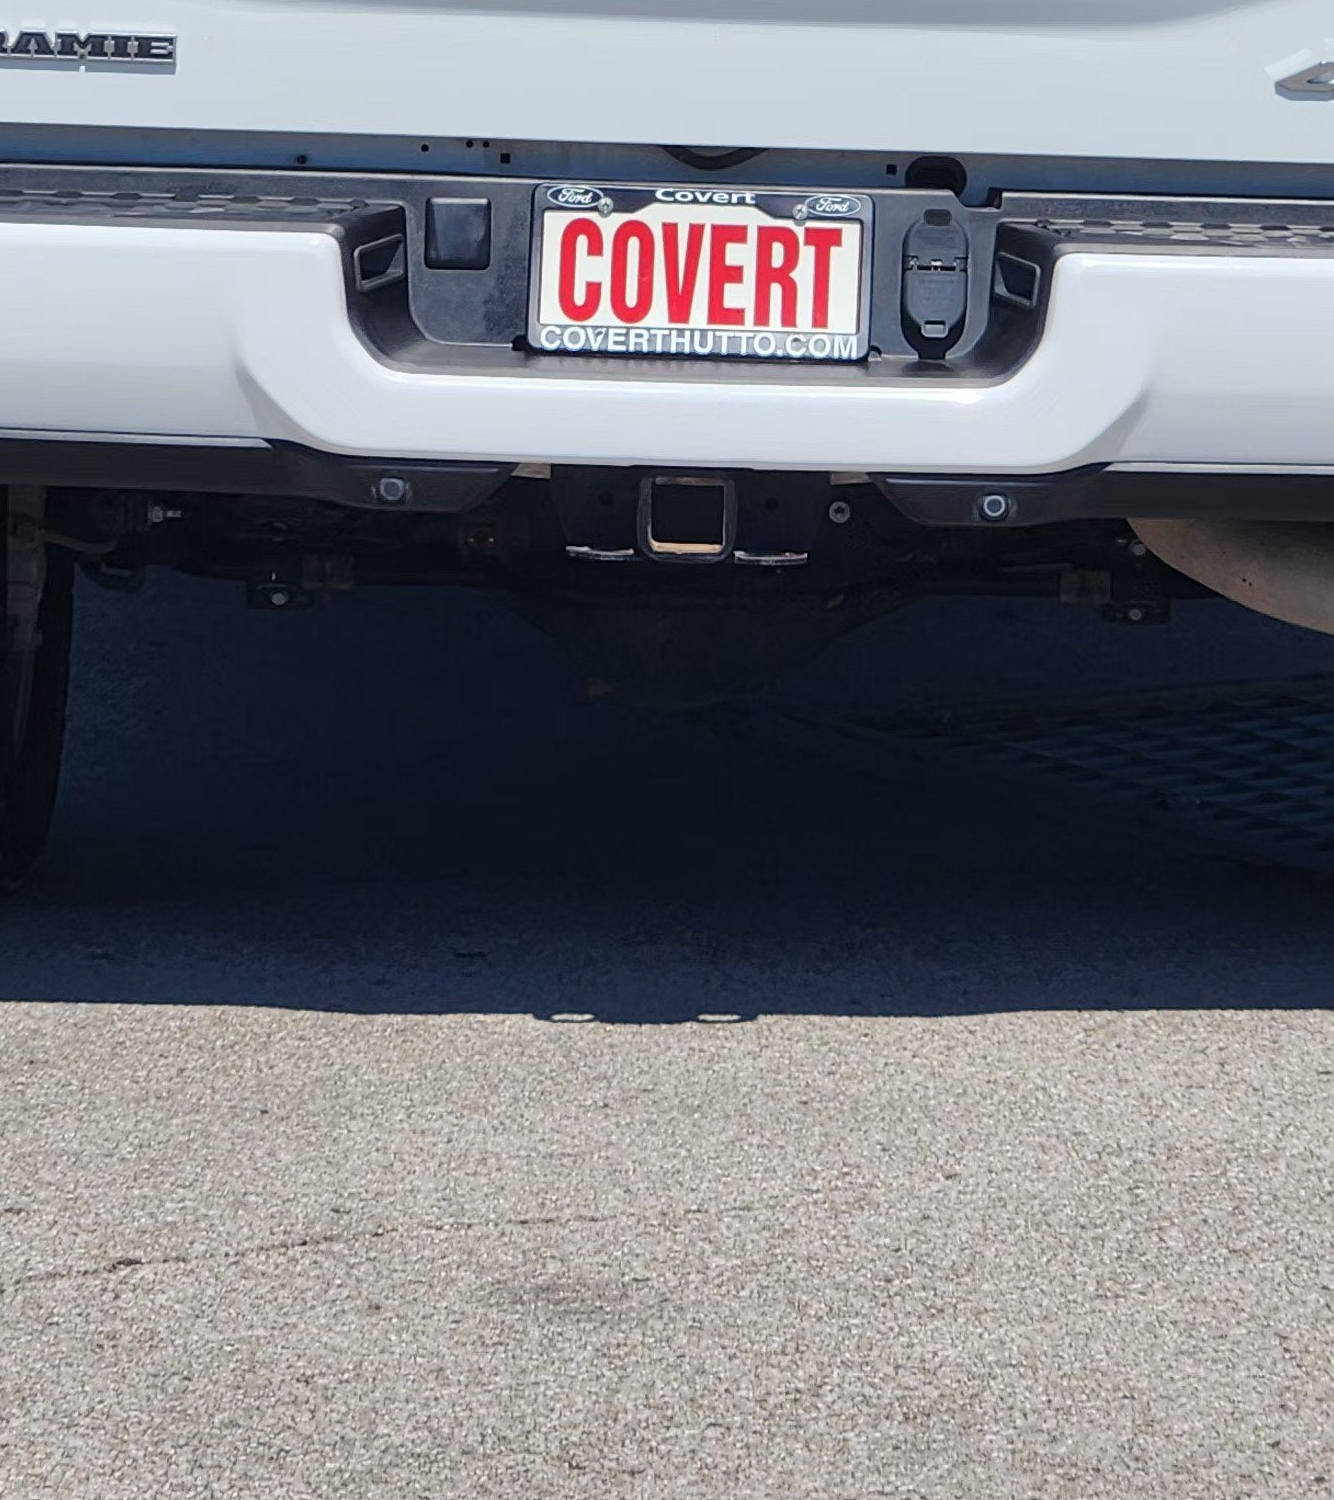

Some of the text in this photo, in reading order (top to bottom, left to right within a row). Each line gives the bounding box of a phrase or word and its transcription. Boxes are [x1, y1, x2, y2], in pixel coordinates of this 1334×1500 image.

[556, 187, 593, 205] Ford
[655, 187, 757, 205] Covert
[814, 196, 851, 213] Ford
[557, 216, 843, 330] COVERT
[539, 326, 858, 360] COVERTHUTTO.COM
